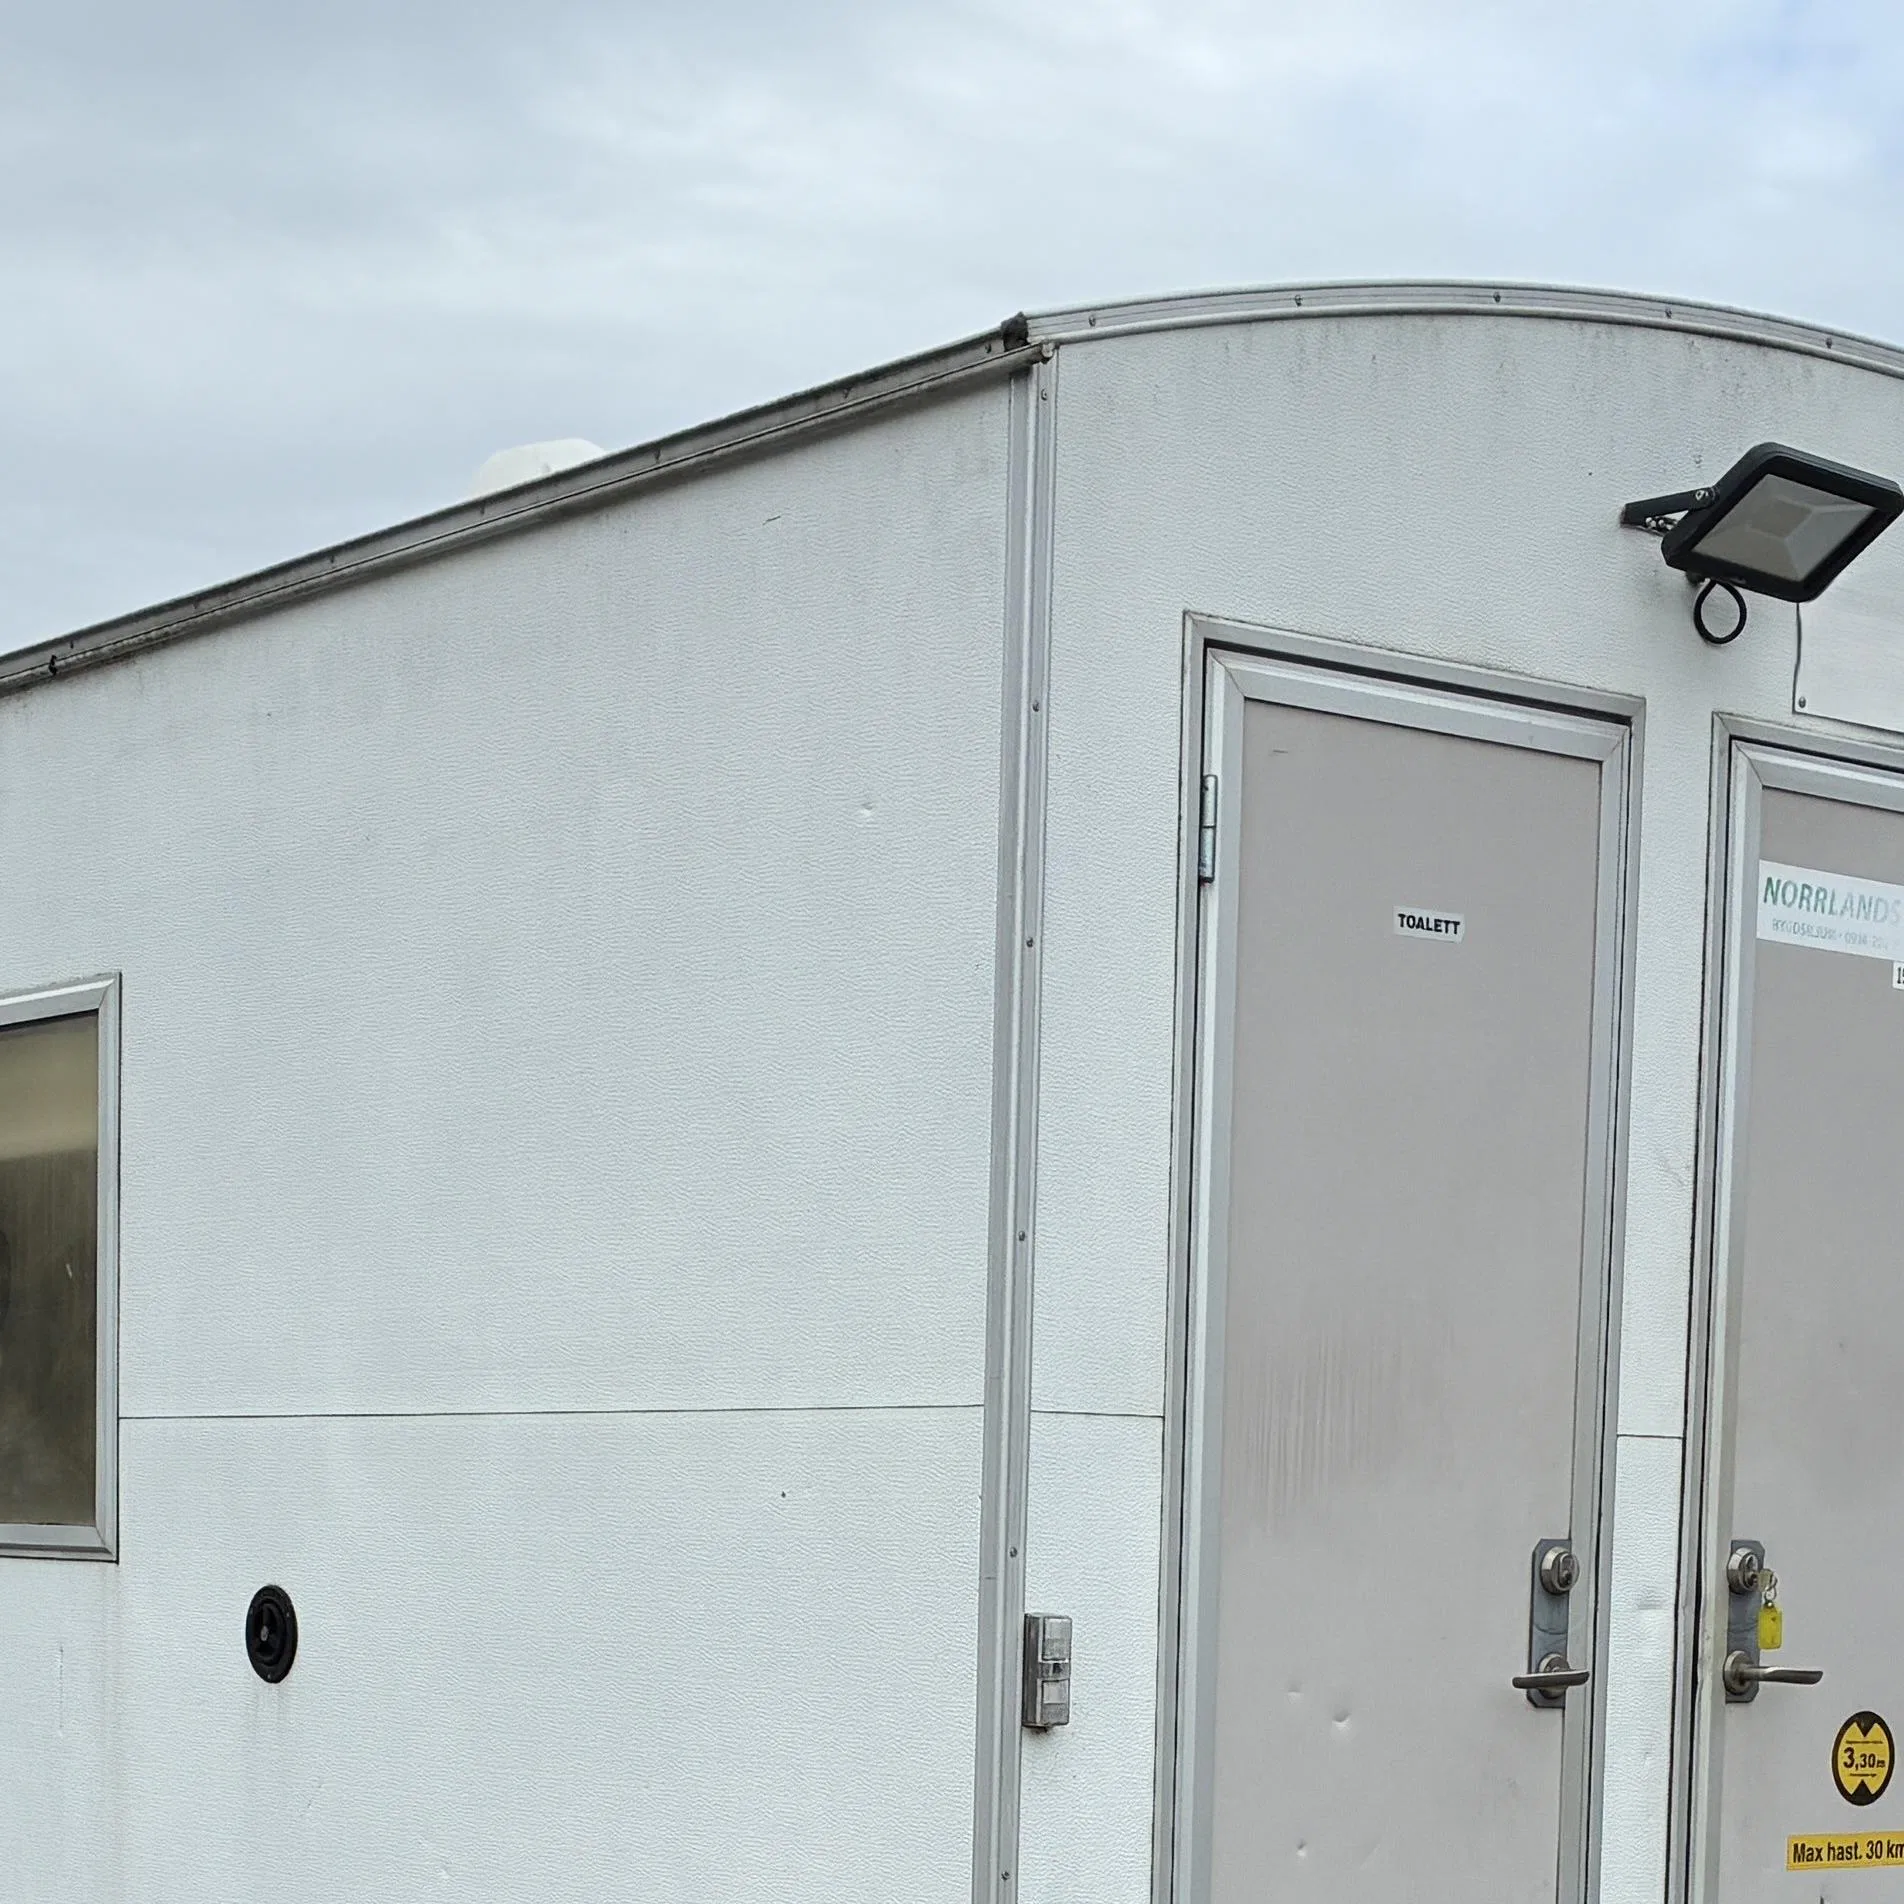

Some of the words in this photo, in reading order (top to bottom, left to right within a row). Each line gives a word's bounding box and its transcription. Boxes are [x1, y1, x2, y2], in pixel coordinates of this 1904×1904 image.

[1763, 877, 1902, 926] NORRLANDS
[1397, 913, 1461, 935] TOALETT
[1793, 1843, 1823, 1863] Max
[1827, 1841, 1863, 1862] hast.
[1866, 1840, 1883, 1860] 30
